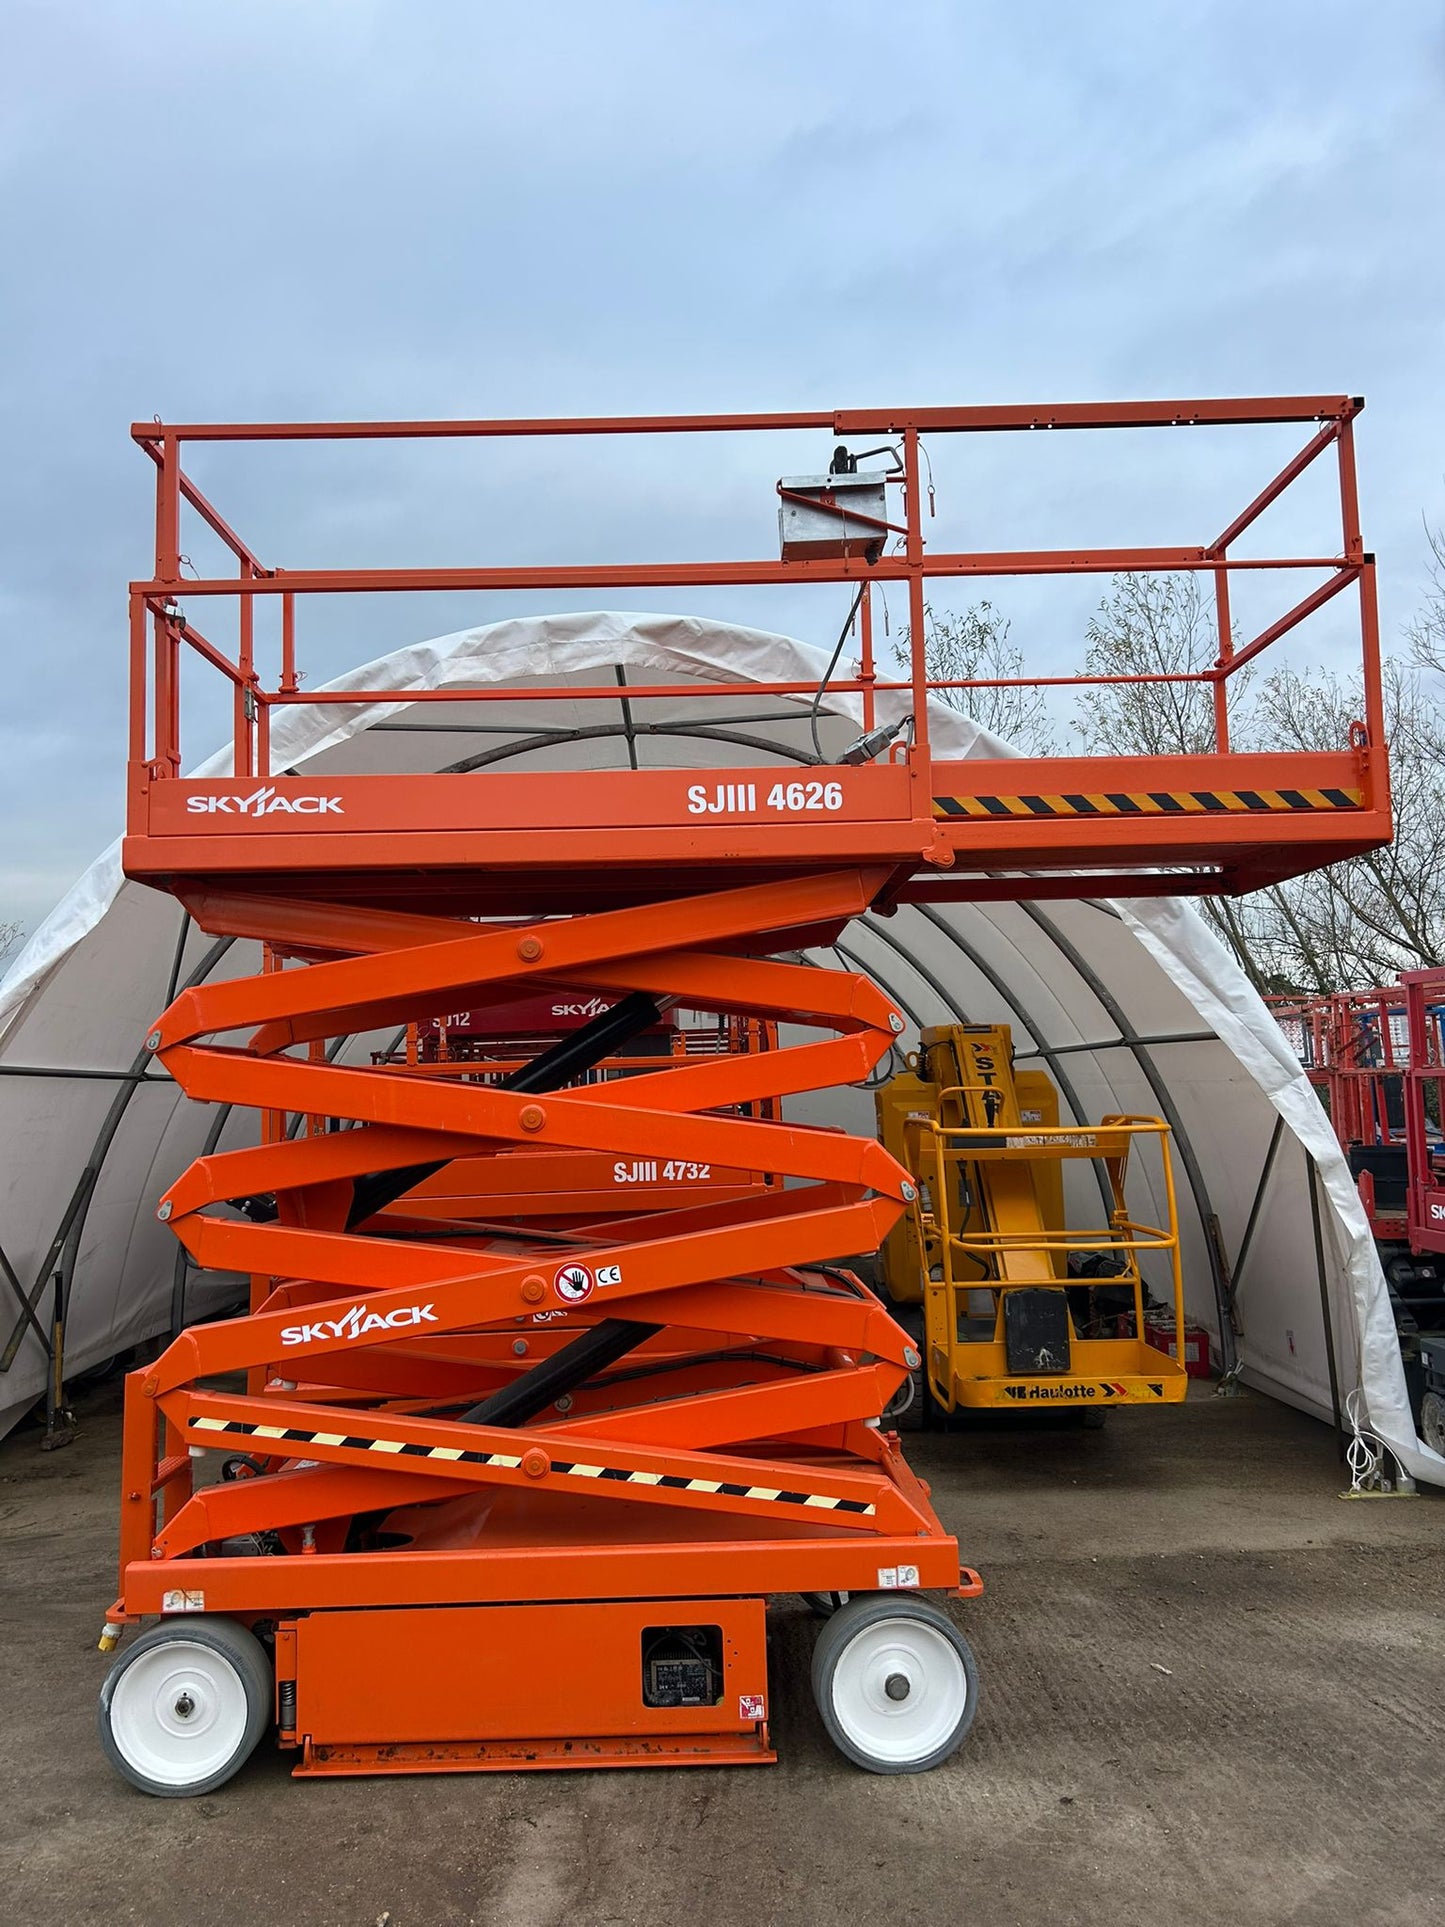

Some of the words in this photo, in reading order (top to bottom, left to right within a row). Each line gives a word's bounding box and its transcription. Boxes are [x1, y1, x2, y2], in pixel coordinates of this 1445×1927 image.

[186, 786, 345, 818] SKYJACK
[687, 784, 756, 814] SJIII
[767, 782, 843, 811] 4626
[551, 997, 617, 1017] SKYJA
[613, 1161, 657, 1183] SJIII
[662, 1160, 711, 1181] 4732
[280, 1303, 439, 1345] SKYJACK
[1028, 1384, 1096, 1400] Haulotte
